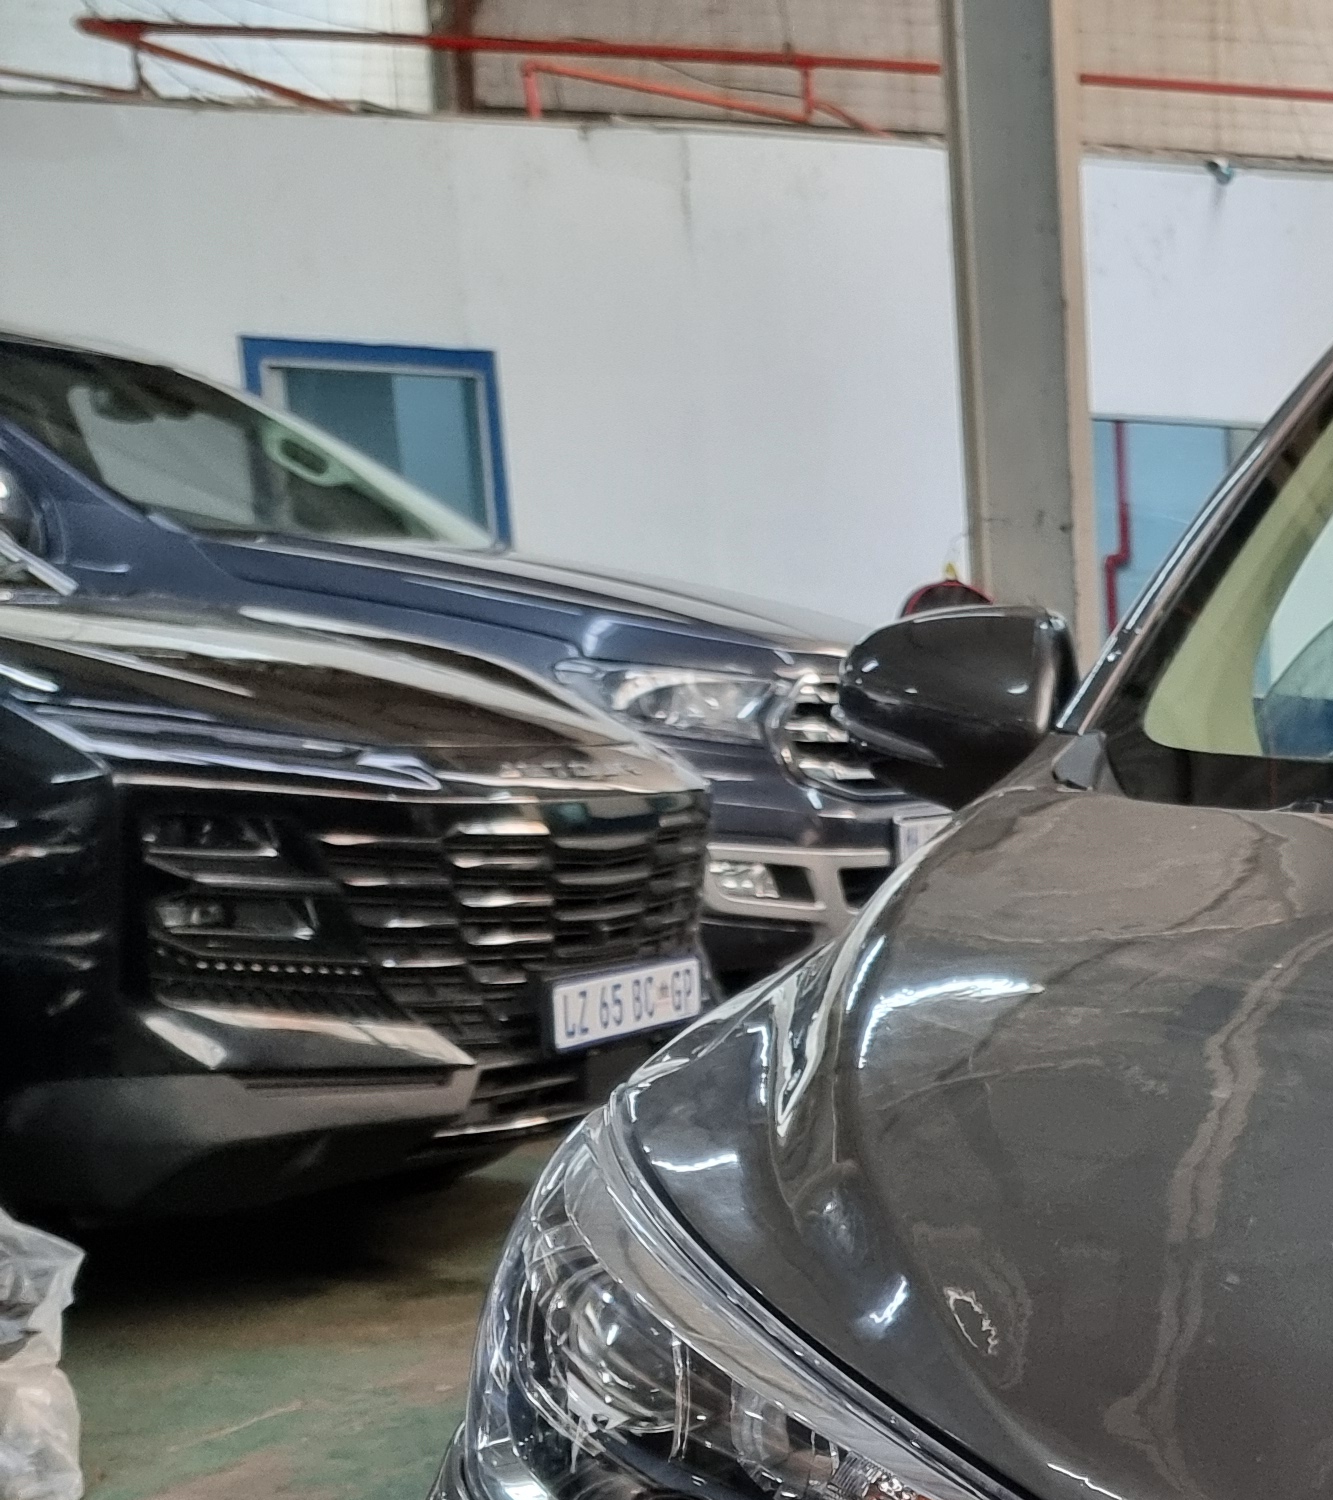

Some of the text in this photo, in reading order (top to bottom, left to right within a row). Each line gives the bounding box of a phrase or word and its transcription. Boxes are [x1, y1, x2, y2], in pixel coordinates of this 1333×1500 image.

[563, 990, 590, 1039] LZ
[598, 983, 624, 1030] 65
[670, 968, 693, 1012] GP
